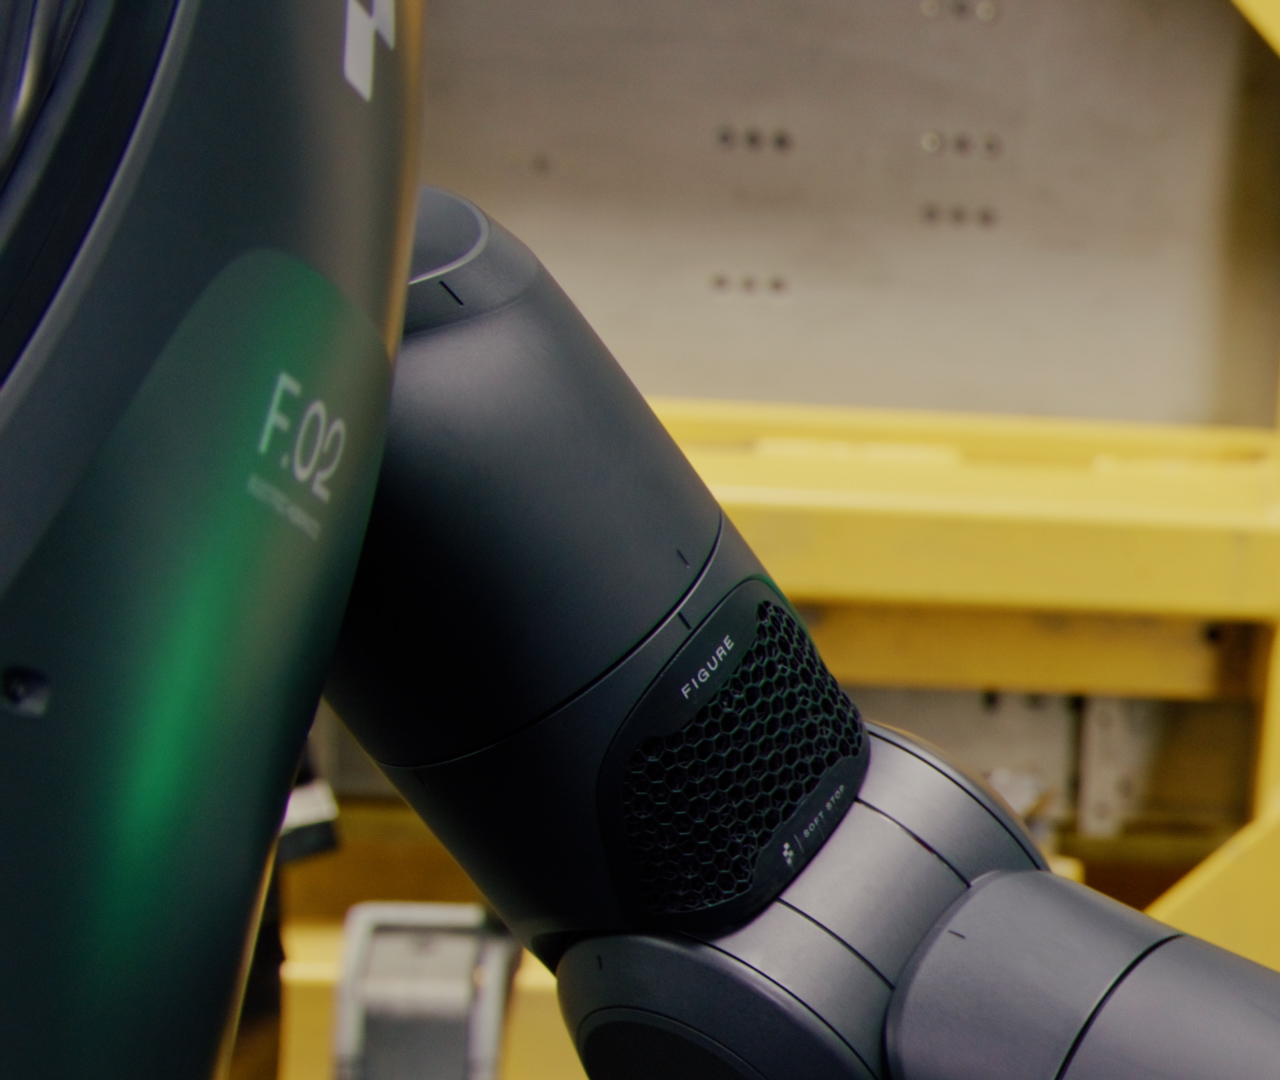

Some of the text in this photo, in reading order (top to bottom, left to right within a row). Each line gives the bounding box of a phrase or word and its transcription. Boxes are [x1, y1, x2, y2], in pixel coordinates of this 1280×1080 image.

[258, 371, 347, 504] F.02
[680, 634, 735, 700] FIGURE
[803, 784, 845, 838] SOFT STOP
